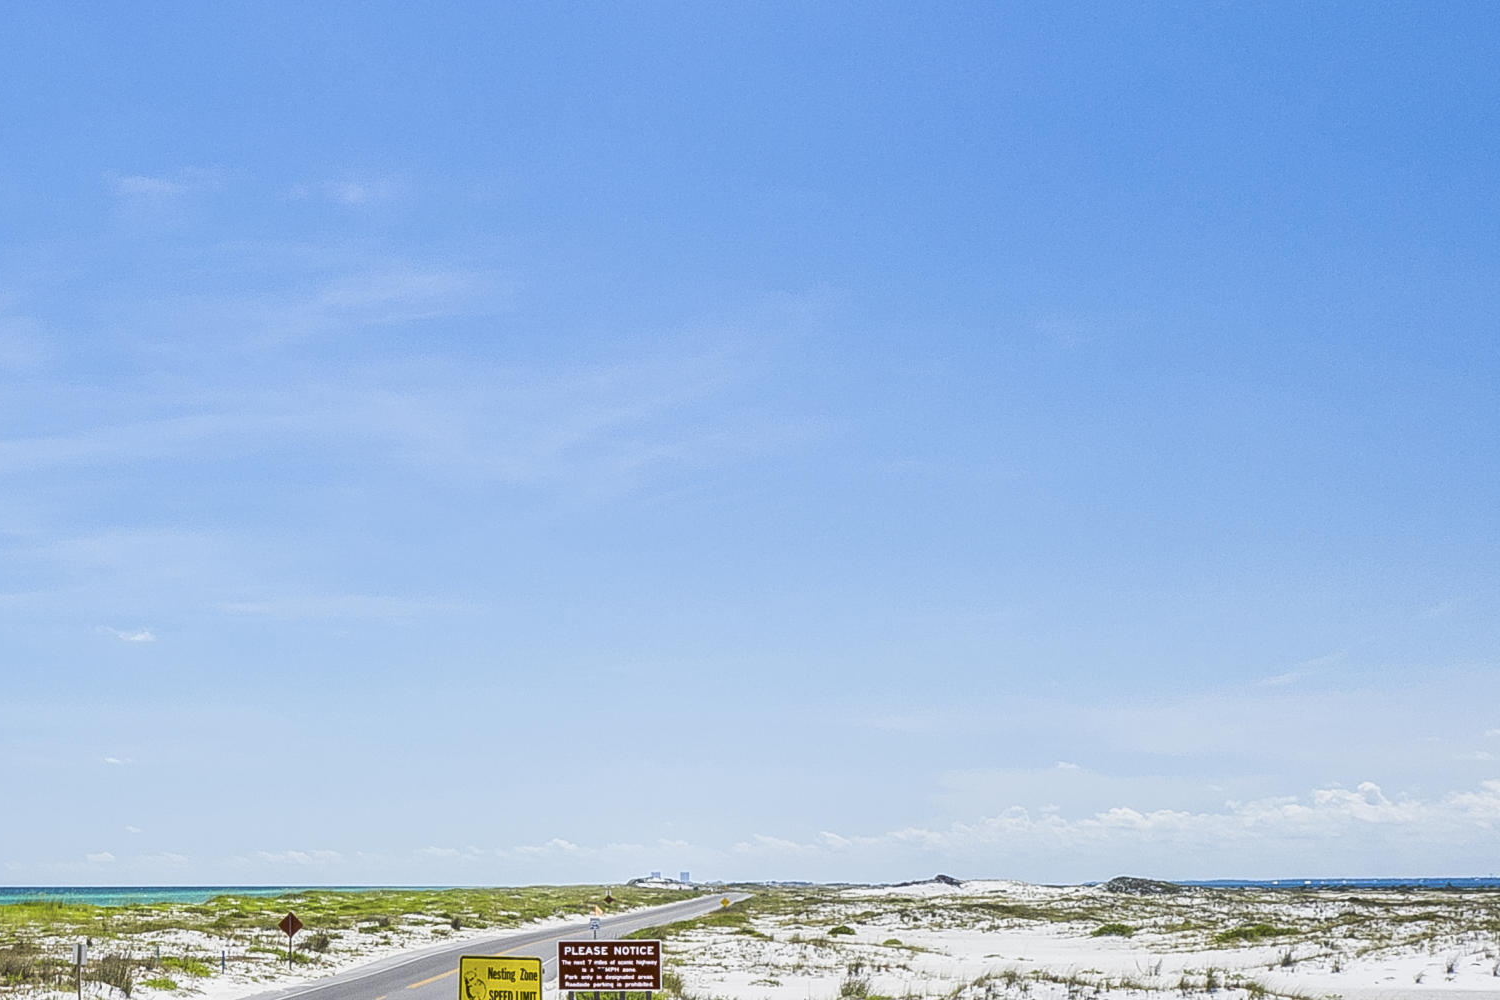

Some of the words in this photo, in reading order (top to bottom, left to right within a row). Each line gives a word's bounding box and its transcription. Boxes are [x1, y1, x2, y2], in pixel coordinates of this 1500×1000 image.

[564, 946, 608, 955] PLEASE
[614, 946, 654, 955] NOTICE
[488, 967, 516, 983] Nesting
[520, 968, 538, 982] Zone
